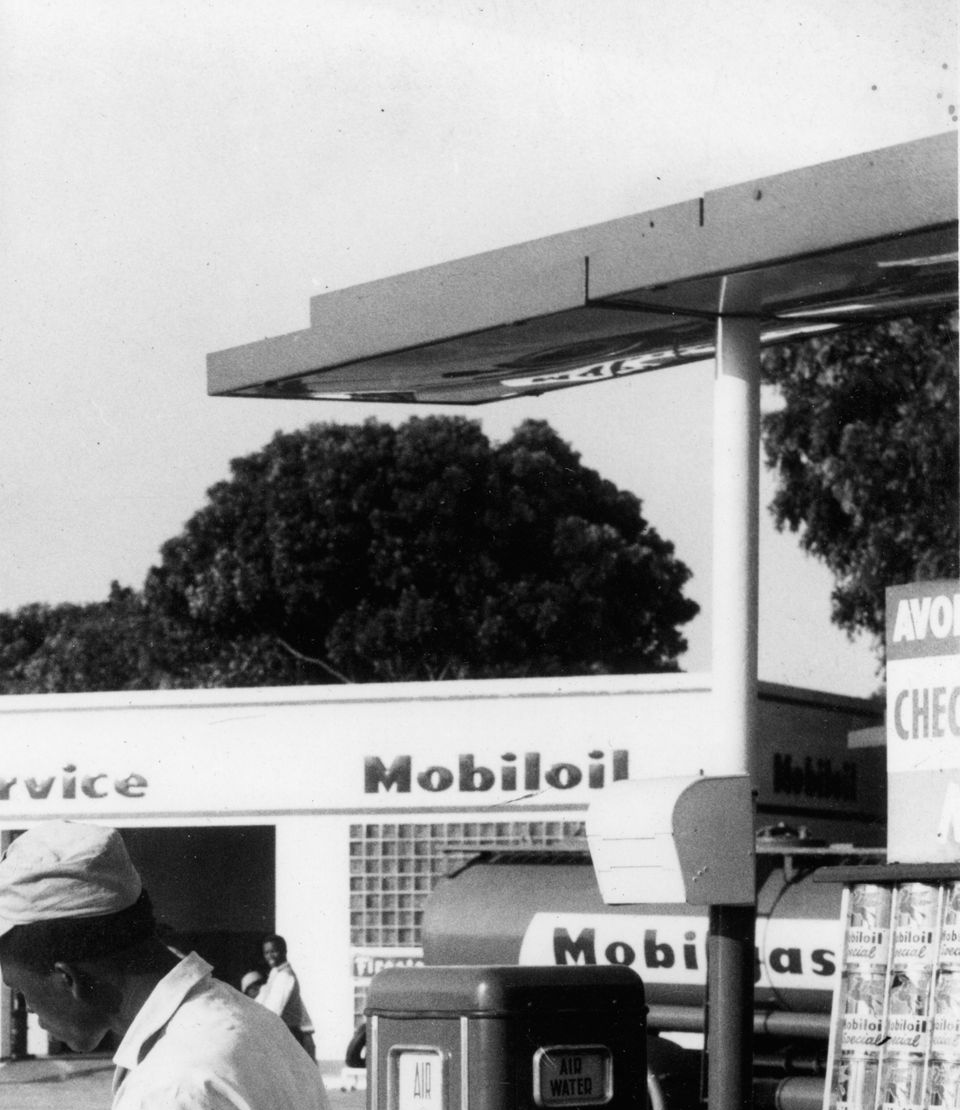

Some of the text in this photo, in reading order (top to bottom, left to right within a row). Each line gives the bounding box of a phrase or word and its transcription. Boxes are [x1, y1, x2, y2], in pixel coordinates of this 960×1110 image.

[365, 750, 629, 793] Mobiloil
[553, 927, 836, 982] Mobias
[413, 1062, 431, 1100] AIR
[559, 1057, 582, 1075] AIR
[550, 1077, 592, 1097] WATER
